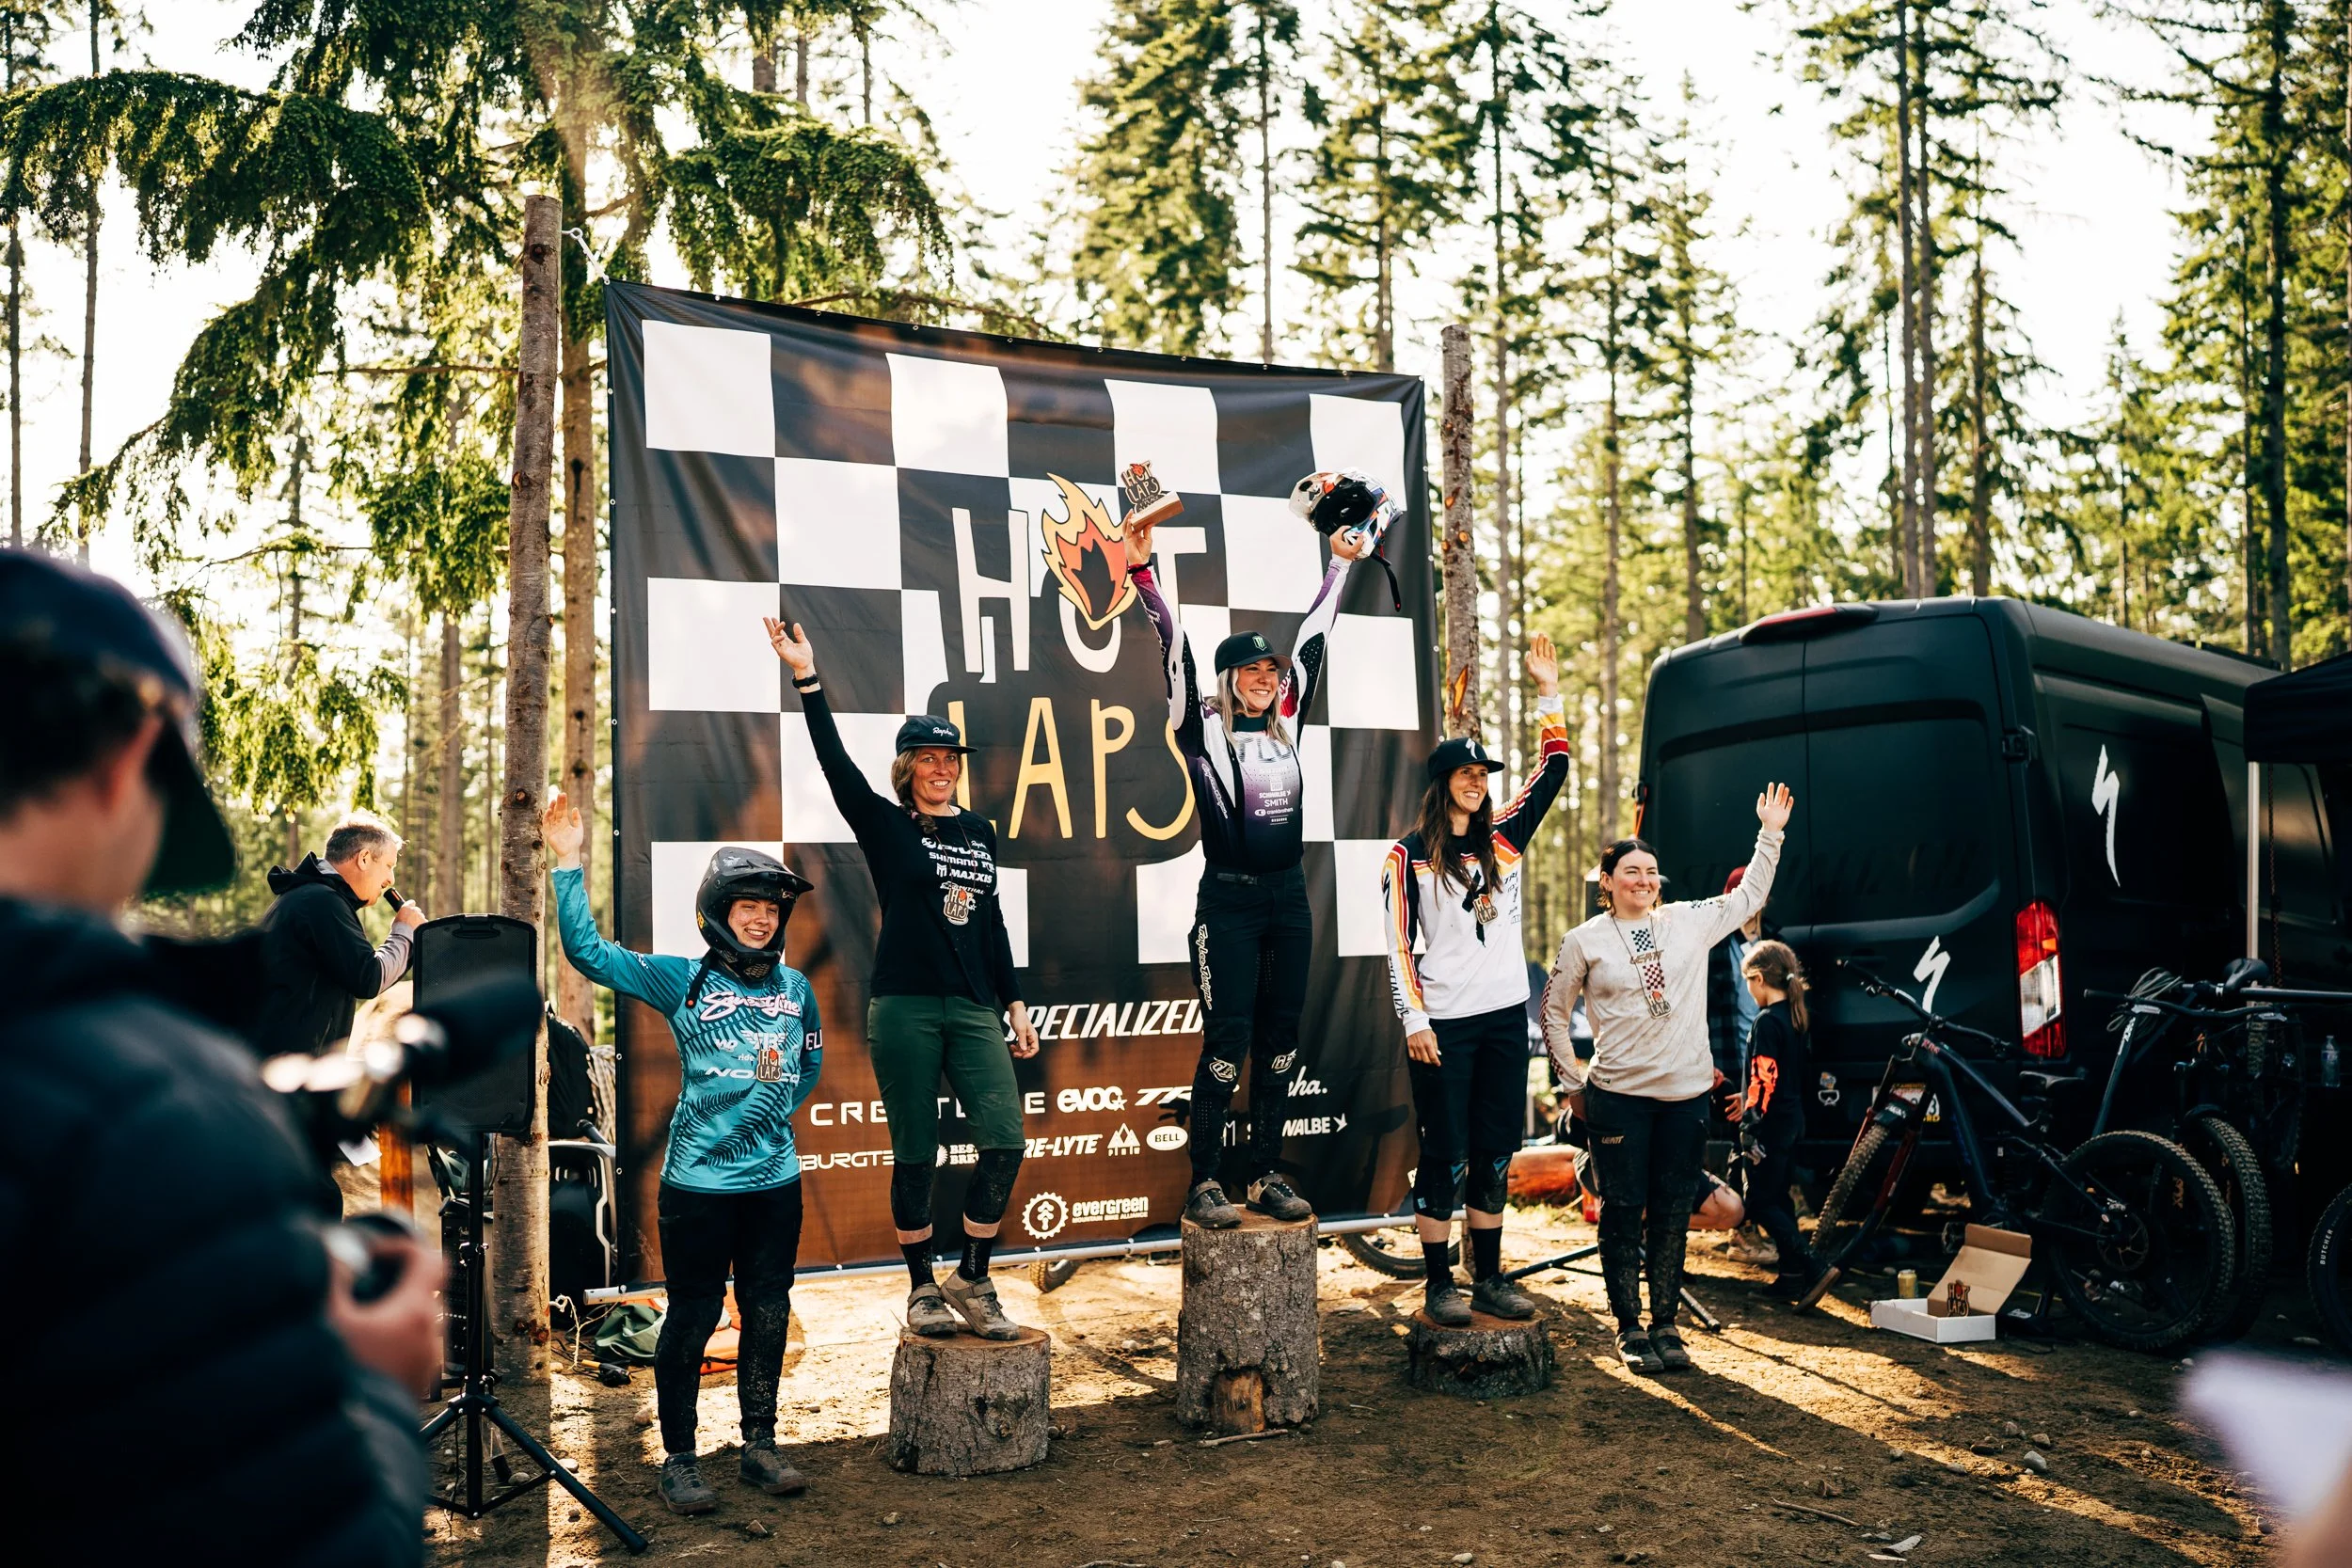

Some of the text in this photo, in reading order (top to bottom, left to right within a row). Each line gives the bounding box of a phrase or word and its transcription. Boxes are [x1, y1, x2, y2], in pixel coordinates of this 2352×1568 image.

[1121, 460, 1152, 486] HOT
[1128, 478, 1159, 501] LAPS
[952, 506, 1207, 673] HOT
[948, 697, 1197, 841] LAPS
[1263, 798, 1289, 807] SMITH
[929, 851, 978, 866] SHIMANO
[949, 868, 993, 884] MAXXIS
[946, 903, 967, 919] LAPS
[760, 1049, 784, 1066] HOT
[759, 1066, 781, 1080] LAPS
[1154, 1132, 1181, 1143] BELL
[2319, 1228, 2334, 1265] BUTCHER
